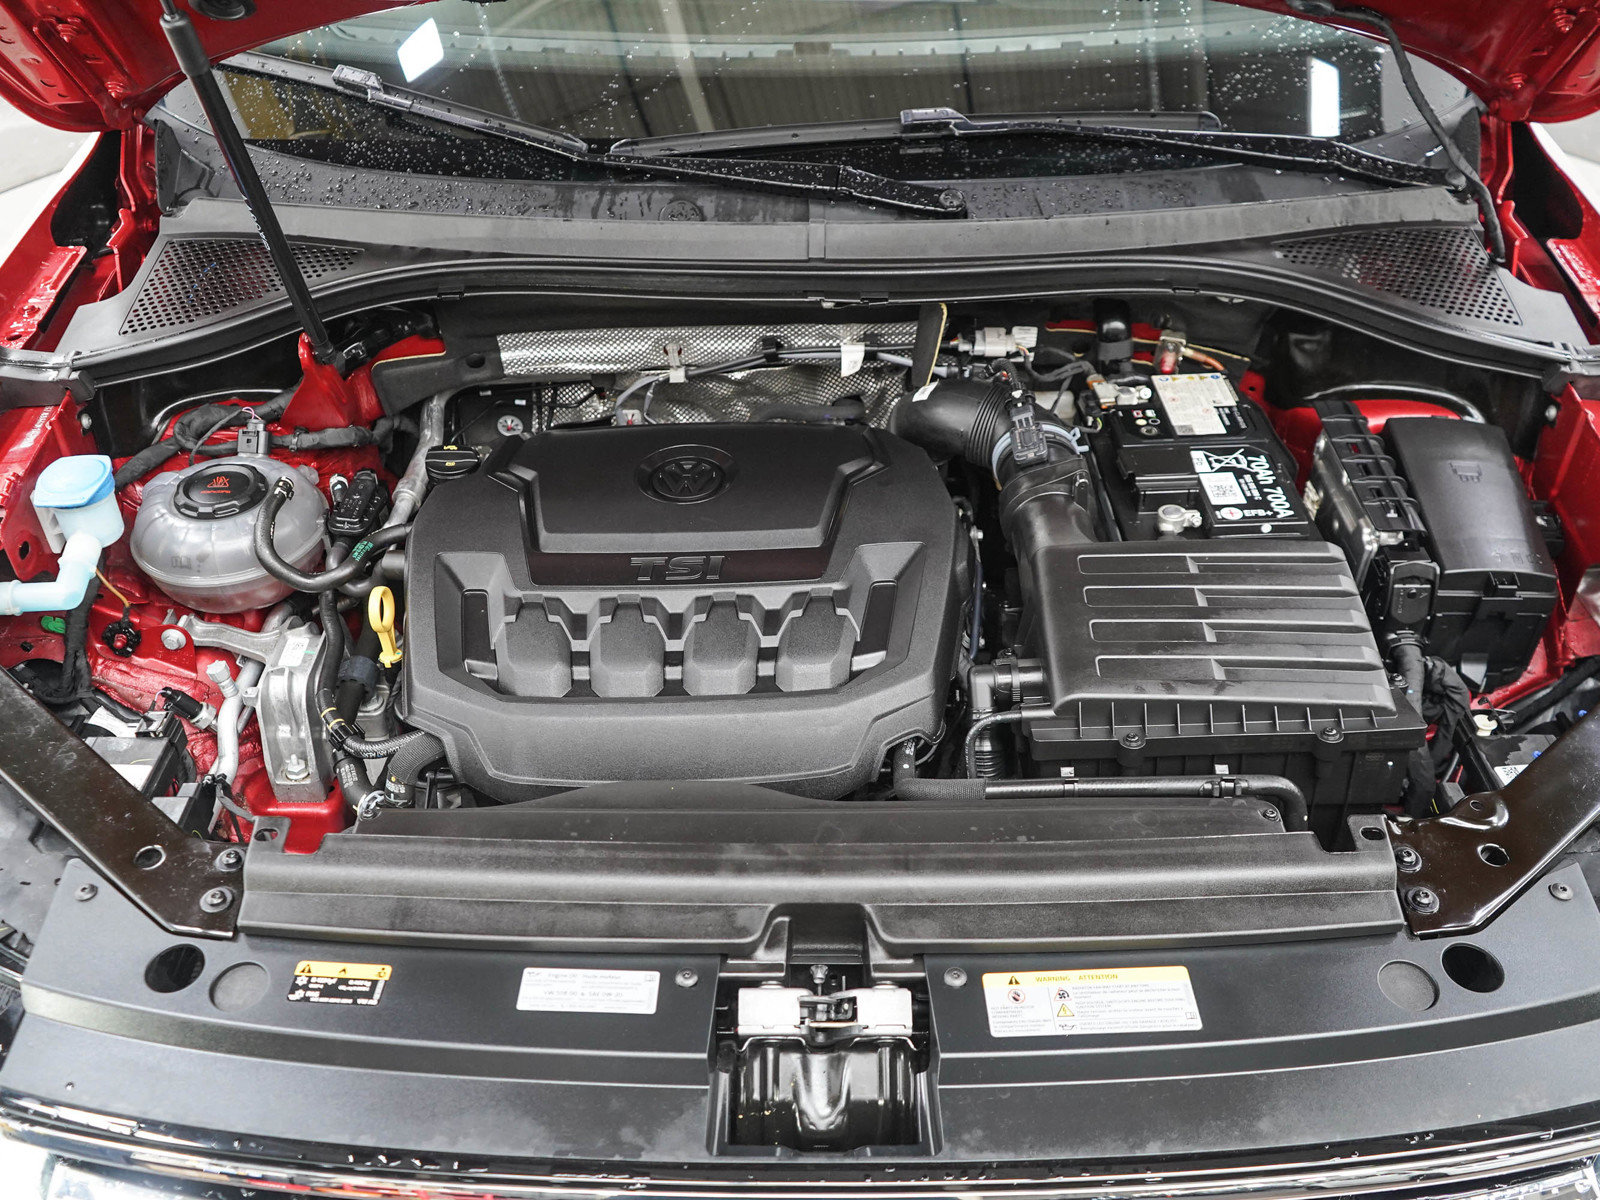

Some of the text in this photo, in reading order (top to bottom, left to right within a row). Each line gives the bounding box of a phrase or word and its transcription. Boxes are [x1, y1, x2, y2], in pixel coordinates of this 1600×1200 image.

[1247, 454, 1276, 485] 70Ah
[1263, 486, 1295, 519] 700A
[630, 556, 725, 581] TSI
[1035, 973, 1118, 983] WARNING ATTENTION
